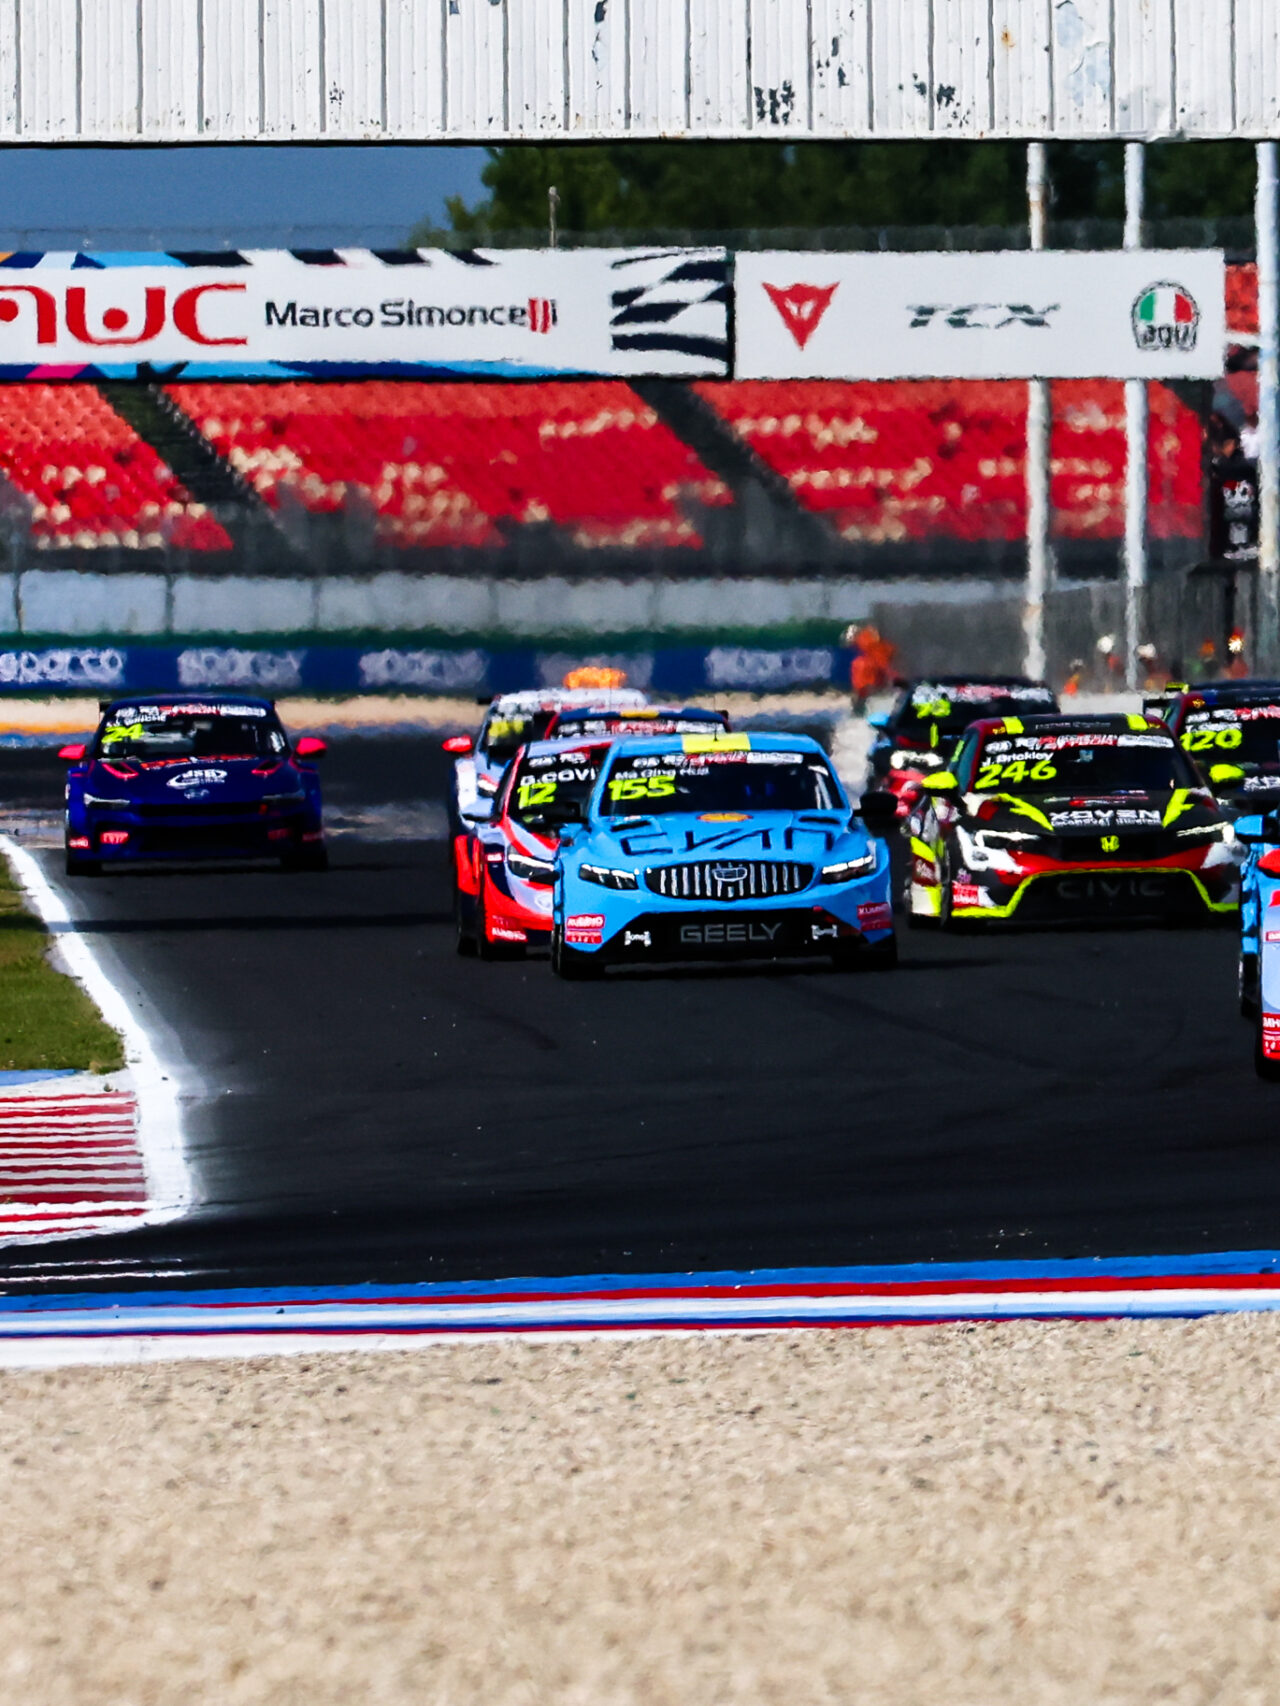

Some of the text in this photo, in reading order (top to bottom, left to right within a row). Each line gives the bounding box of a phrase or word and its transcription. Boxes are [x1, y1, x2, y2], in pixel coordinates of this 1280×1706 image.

[265, 298, 557, 334] Marco Simoncelli
[102, 723, 143, 744] 24
[1180, 728, 1243, 751] 120
[975, 760, 1057, 789] 246
[517, 781, 558, 809] 12
[607, 776, 676, 801] 155
[1057, 878, 1165, 899] CIVIC
[679, 922, 783, 944] GEELY
